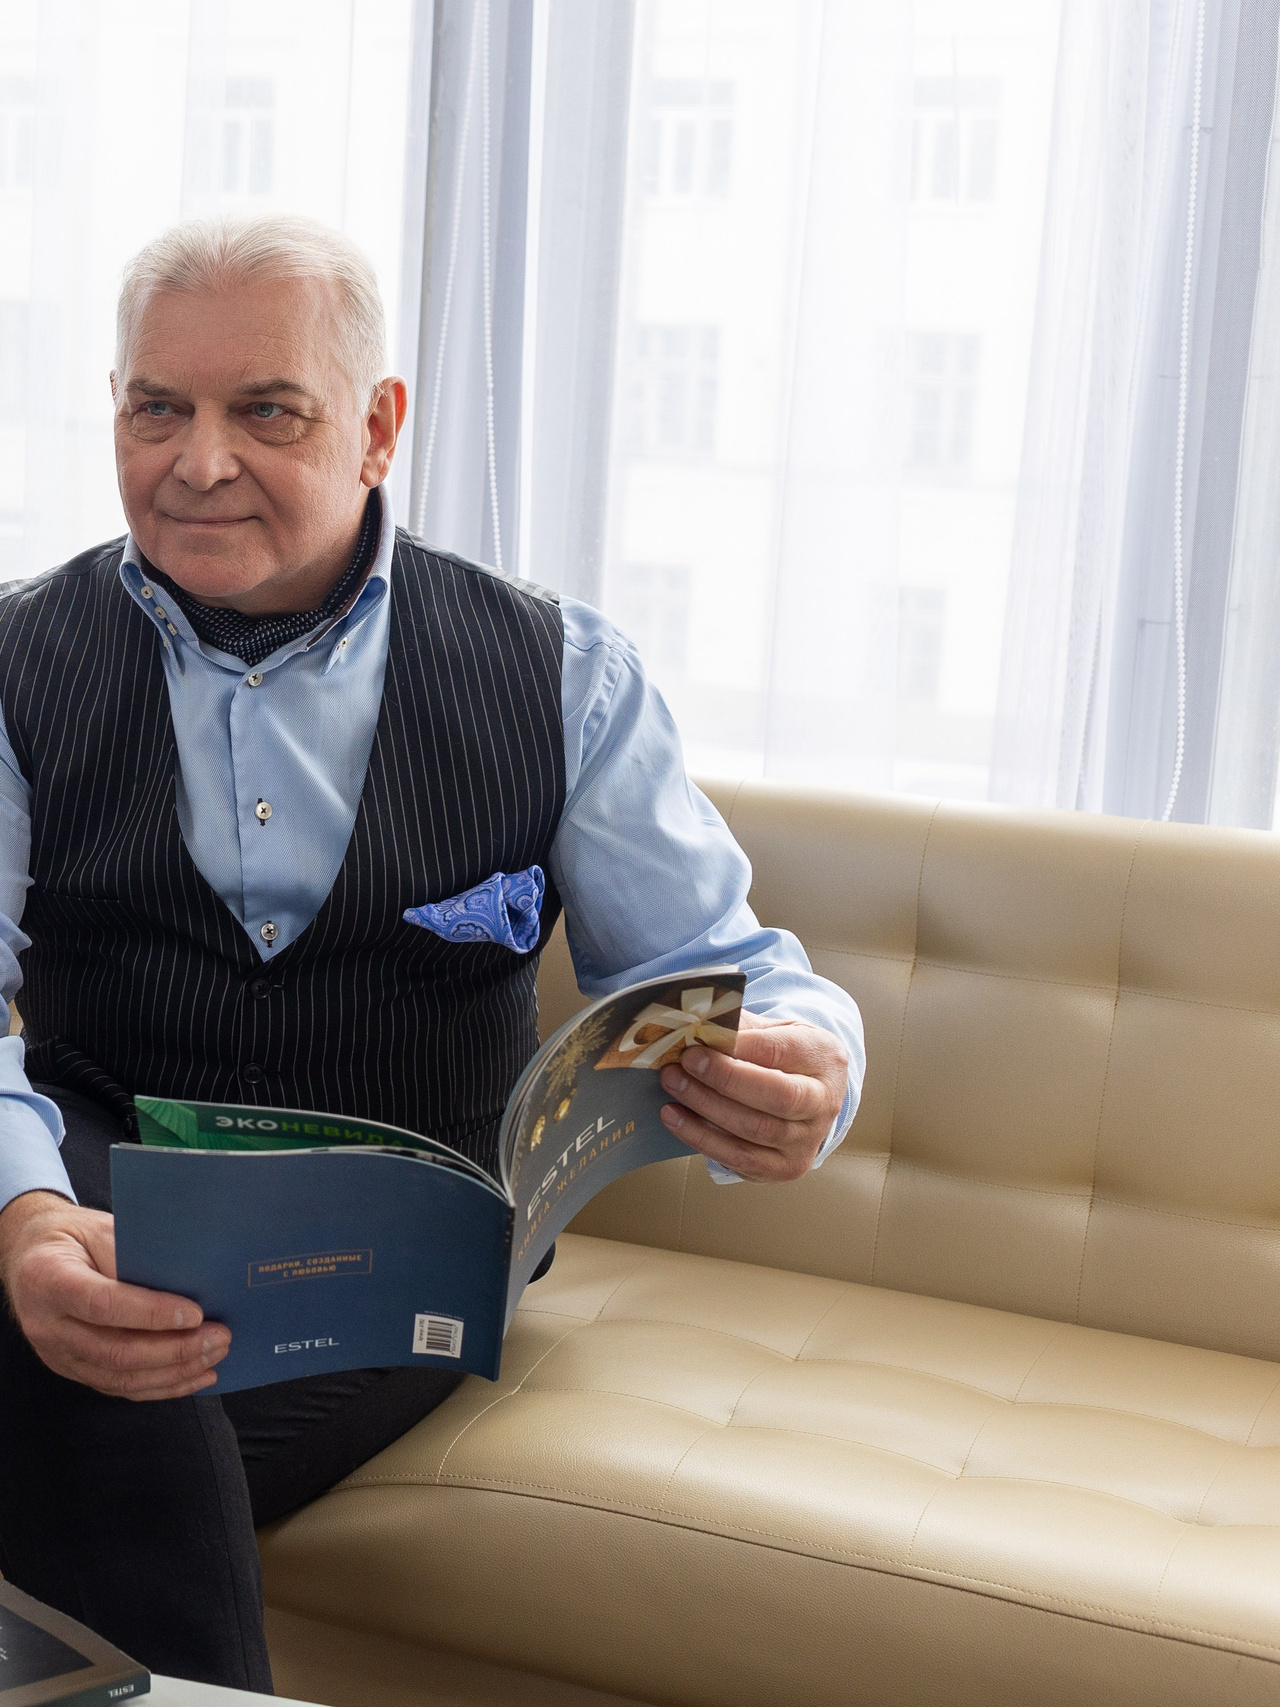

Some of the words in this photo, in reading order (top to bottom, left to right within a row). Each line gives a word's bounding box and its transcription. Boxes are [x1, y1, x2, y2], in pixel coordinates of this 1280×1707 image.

[556, 1119, 636, 1197] ЖЕЛАНИЙ
[527, 1115, 617, 1222] ESTEL
[258, 1260, 304, 1274] ПОДАРКИ,
[306, 1254, 363, 1266] СОЗДАННЫЕ
[282, 1270, 289, 1278] С
[291, 1264, 337, 1277] ЛЮБОВЬЮ
[274, 1337, 340, 1354] ESTEL
[107, 1683, 135, 1699] ESTEL
